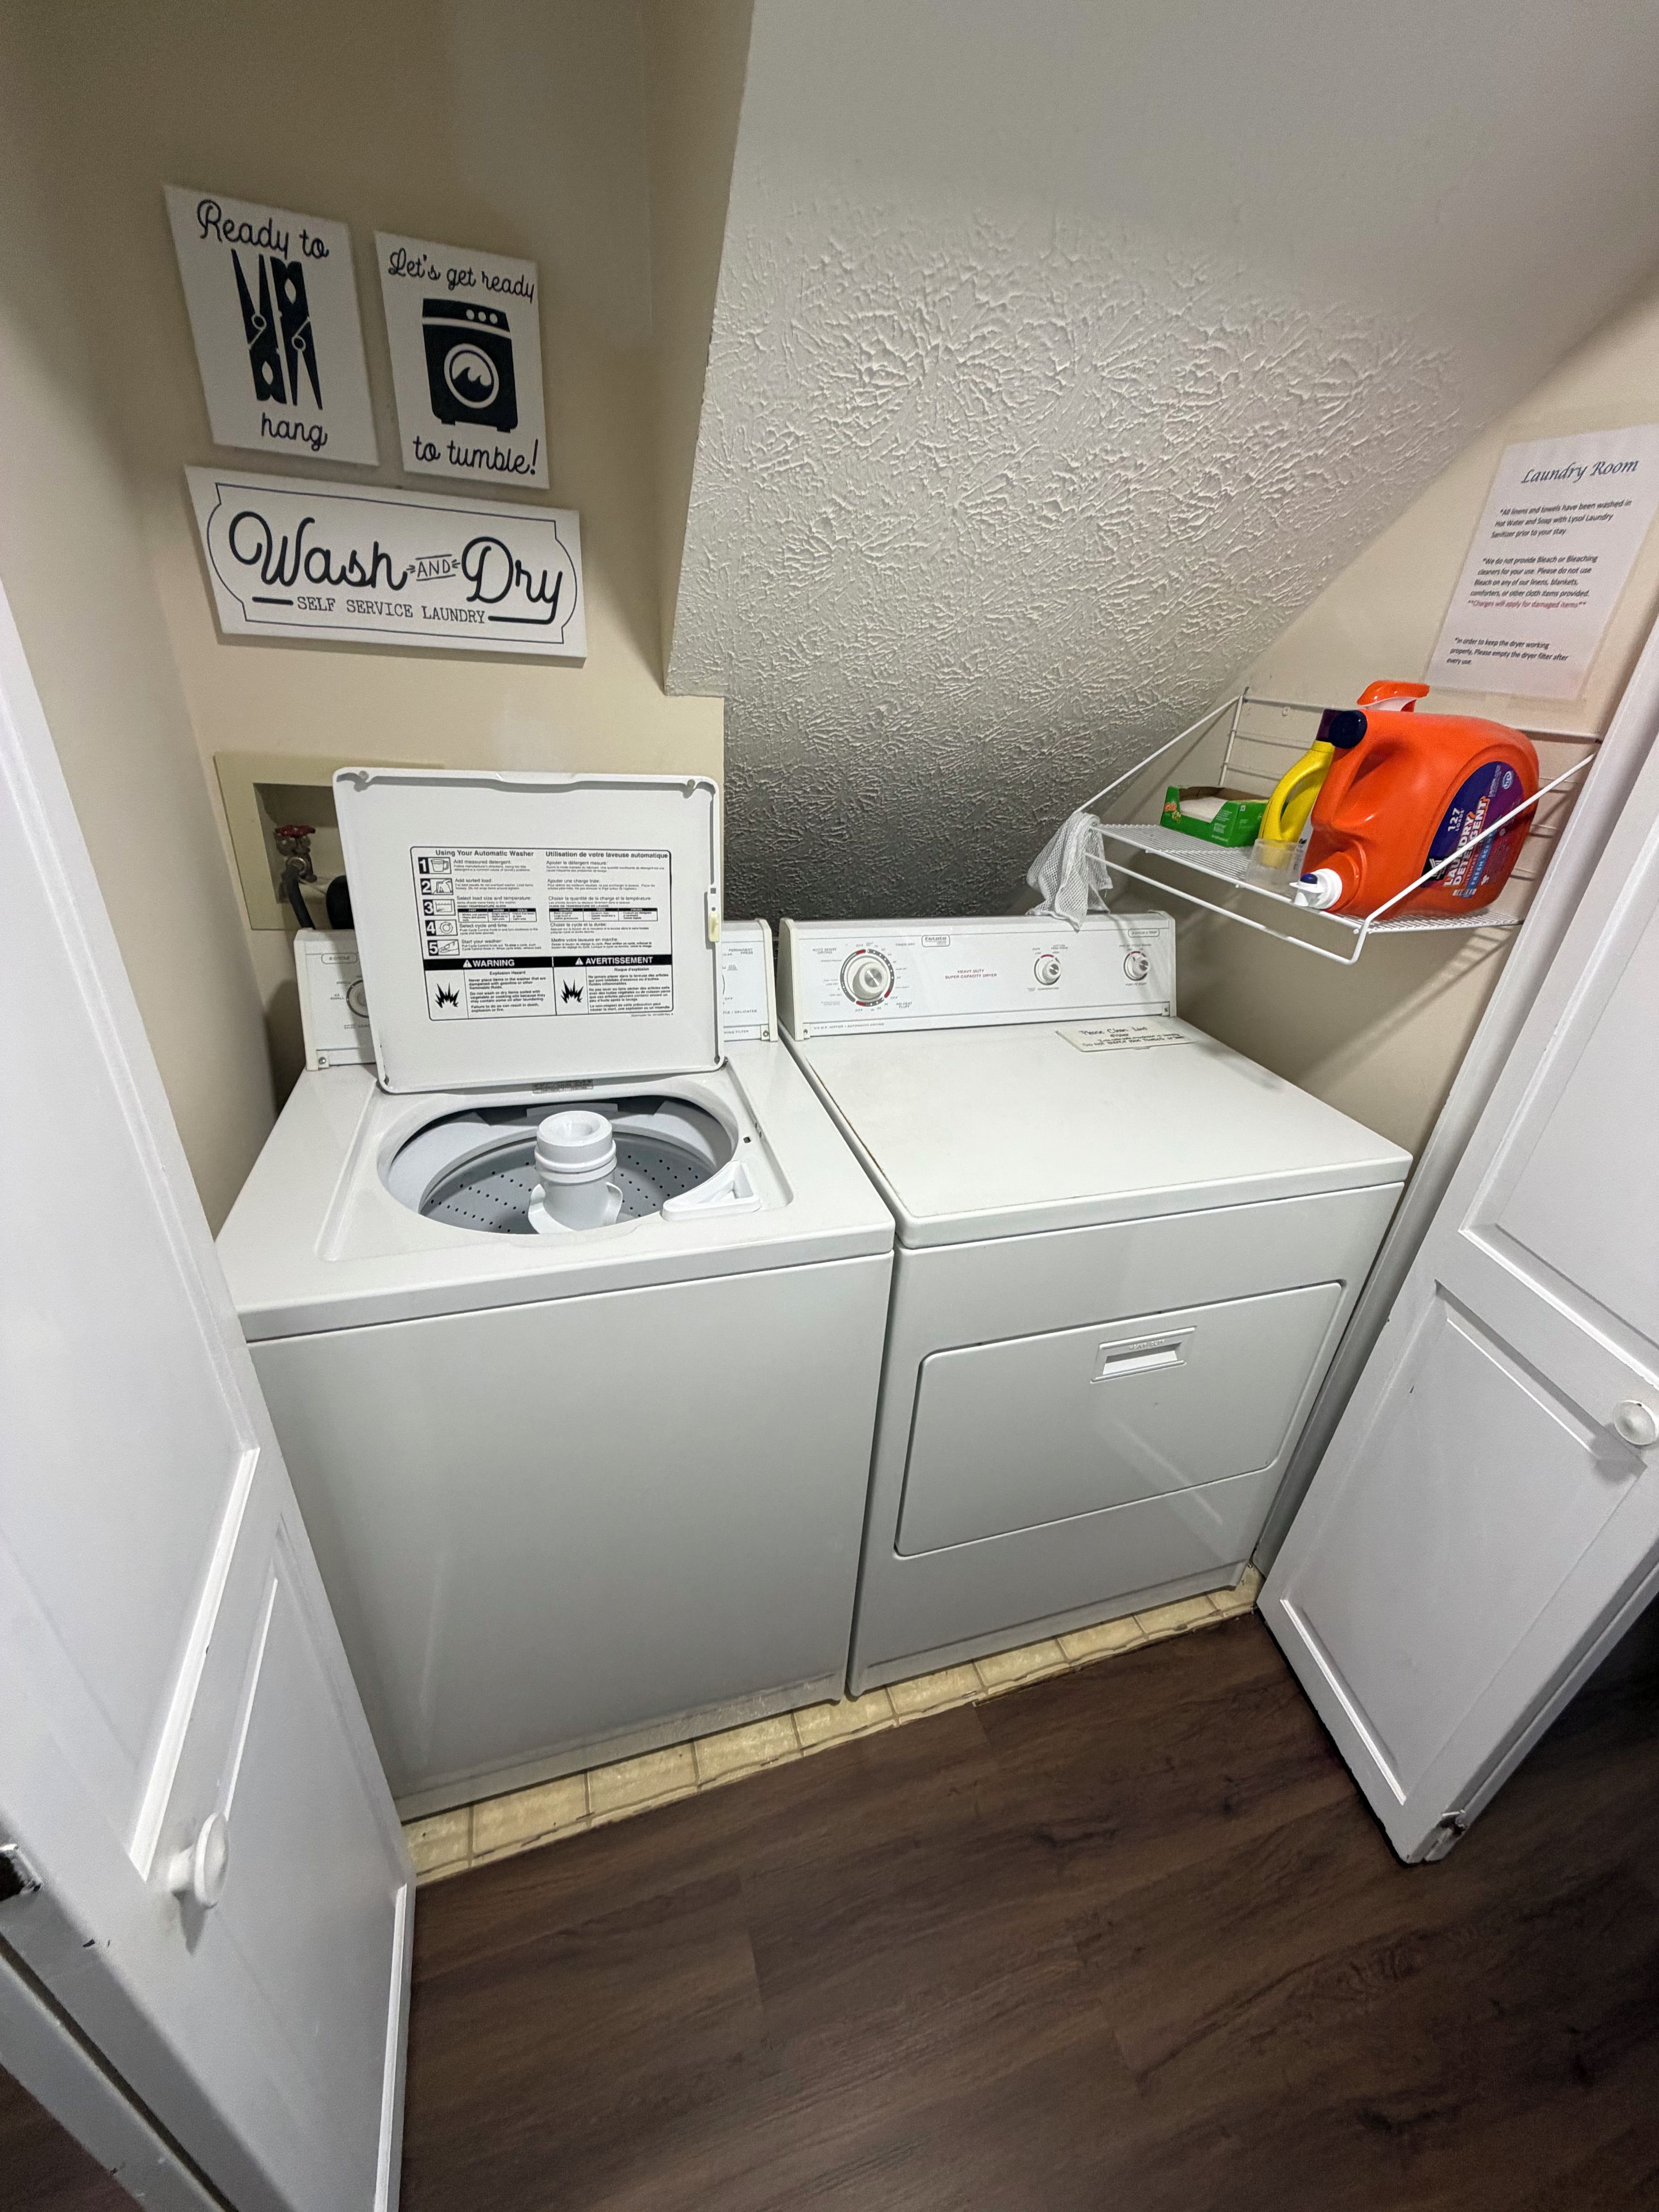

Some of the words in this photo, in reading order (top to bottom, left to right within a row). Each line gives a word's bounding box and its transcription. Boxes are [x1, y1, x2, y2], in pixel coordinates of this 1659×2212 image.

[196, 199, 289, 260] Ready
[299, 229, 329, 259] to
[388, 248, 441, 281] Let's
[446, 267, 476, 291] get
[481, 271, 535, 304] ready
[261, 412, 328, 452] hang
[412, 435, 441, 462] to
[446, 438, 539, 475] tumble!
[1521, 461, 1588, 483] Laundry
[1590, 460, 1639, 476] Room
[1597, 499, 1624, 509] washed
[1567, 516, 1585, 524] Lysol
[1586, 513, 1614, 522] Laundry
[1537, 529, 1552, 537] your
[1514, 557, 1536, 565] provide
[1566, 555, 1599, 564] Bleaching
[228, 510, 408, 592] Wash
[417, 559, 451, 578] AND
[461, 536, 563, 624] Dry
[297, 596, 336, 612] SELF
[346, 600, 413, 618] SERVICE
[422, 605, 485, 624] LAUNDRY
[1531, 601, 1559, 609] damaged
[1485, 639, 1498, 647] keep
[1509, 641, 1525, 649] dryer
[1526, 642, 1550, 650] working
[1492, 651, 1510, 659] empty
[1521, 652, 1537, 660] dryer
[1447, 807, 1460, 832] 127
[1452, 798, 1488, 886] DETEGENT
[435, 849, 456, 857] Using
[421, 859, 427, 872] 1
[421, 880, 431, 893] 2
[424, 901, 433, 914] 3
[427, 922, 436, 934] 4
[429, 942, 438, 955] 5
[472, 959, 515, 967] WARNING
[585, 957, 653, 965] AVERTISSEMENT
